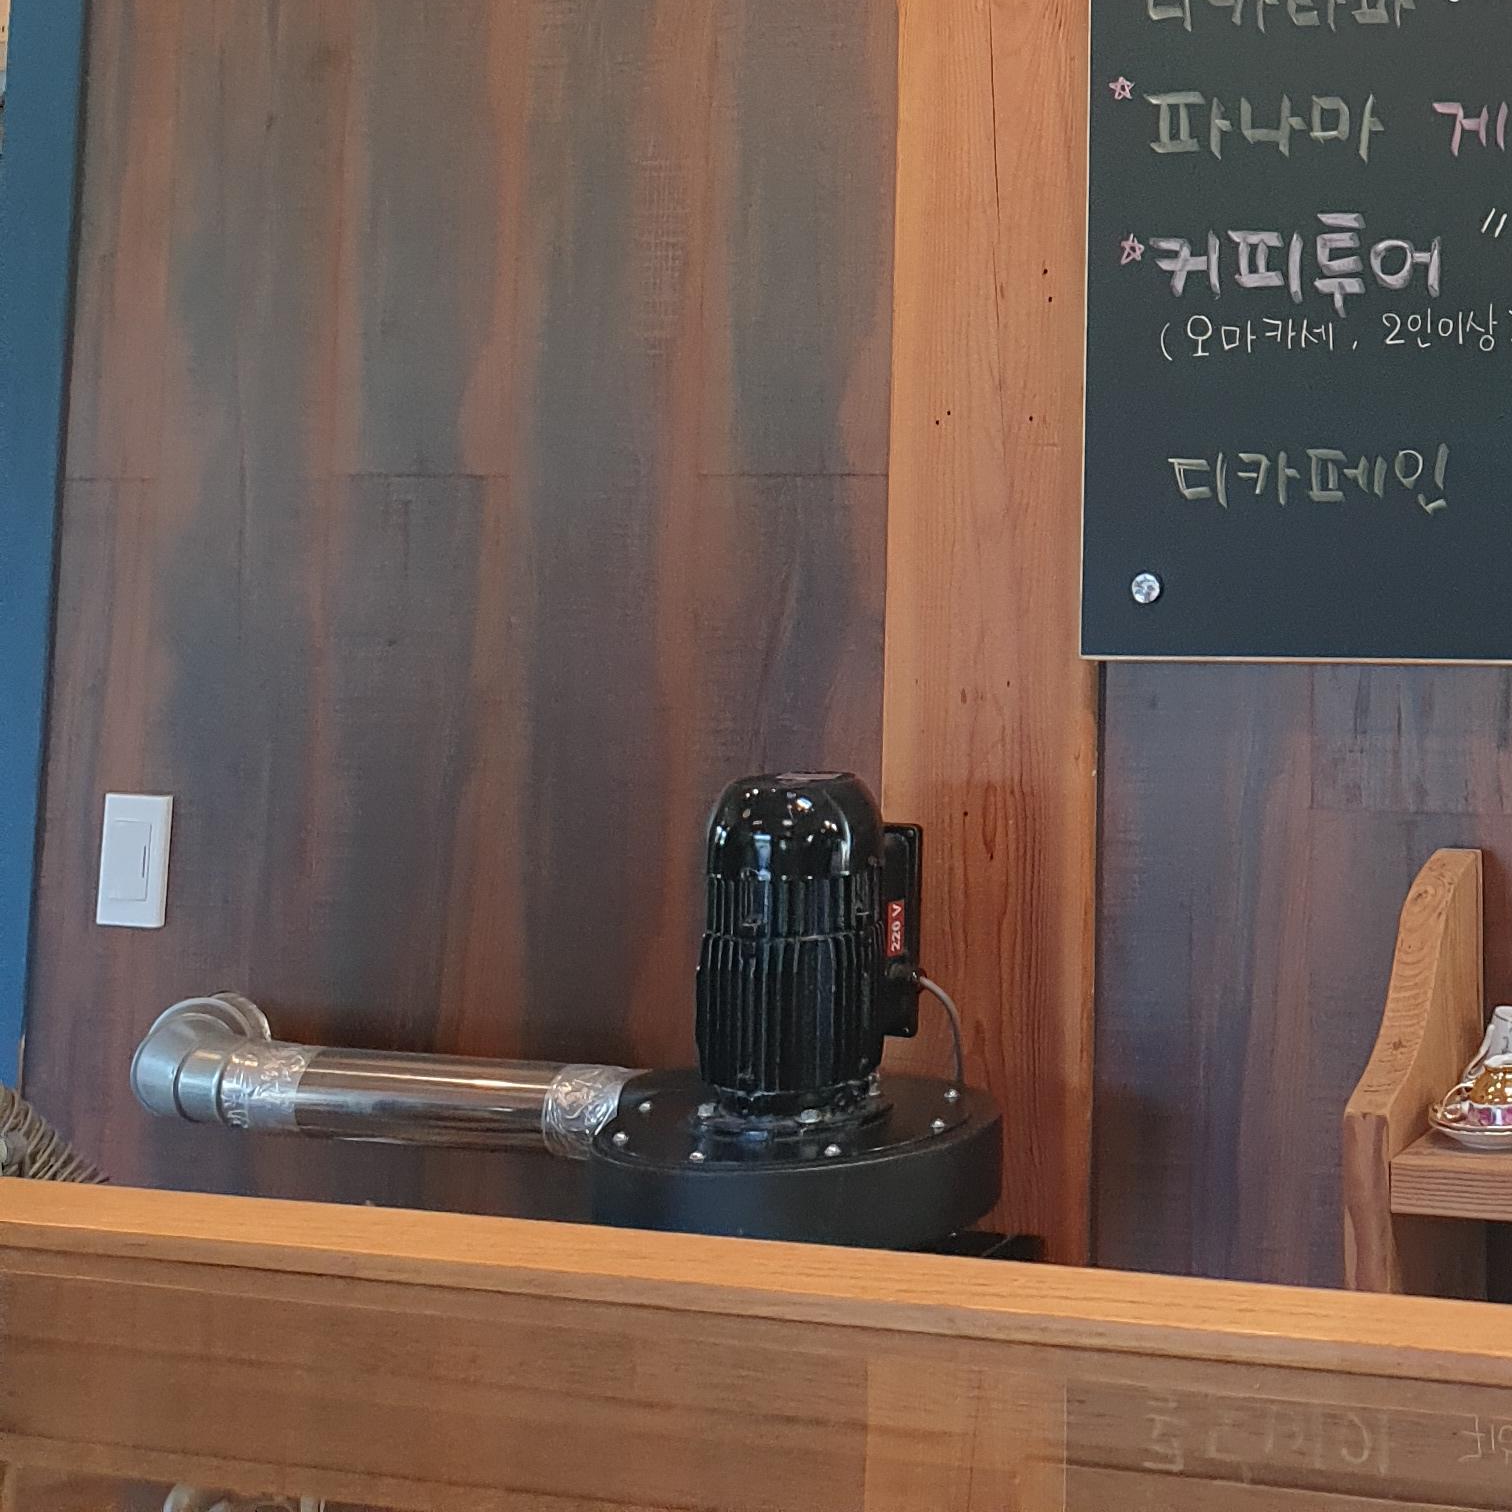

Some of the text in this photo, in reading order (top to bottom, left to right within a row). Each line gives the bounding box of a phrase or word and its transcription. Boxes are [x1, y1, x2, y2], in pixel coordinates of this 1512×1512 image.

[1143, 92, 1385, 164] 파나마
[1150, 212, 1441, 318] 커피투어
[1167, 443, 1450, 515] 디카페인
